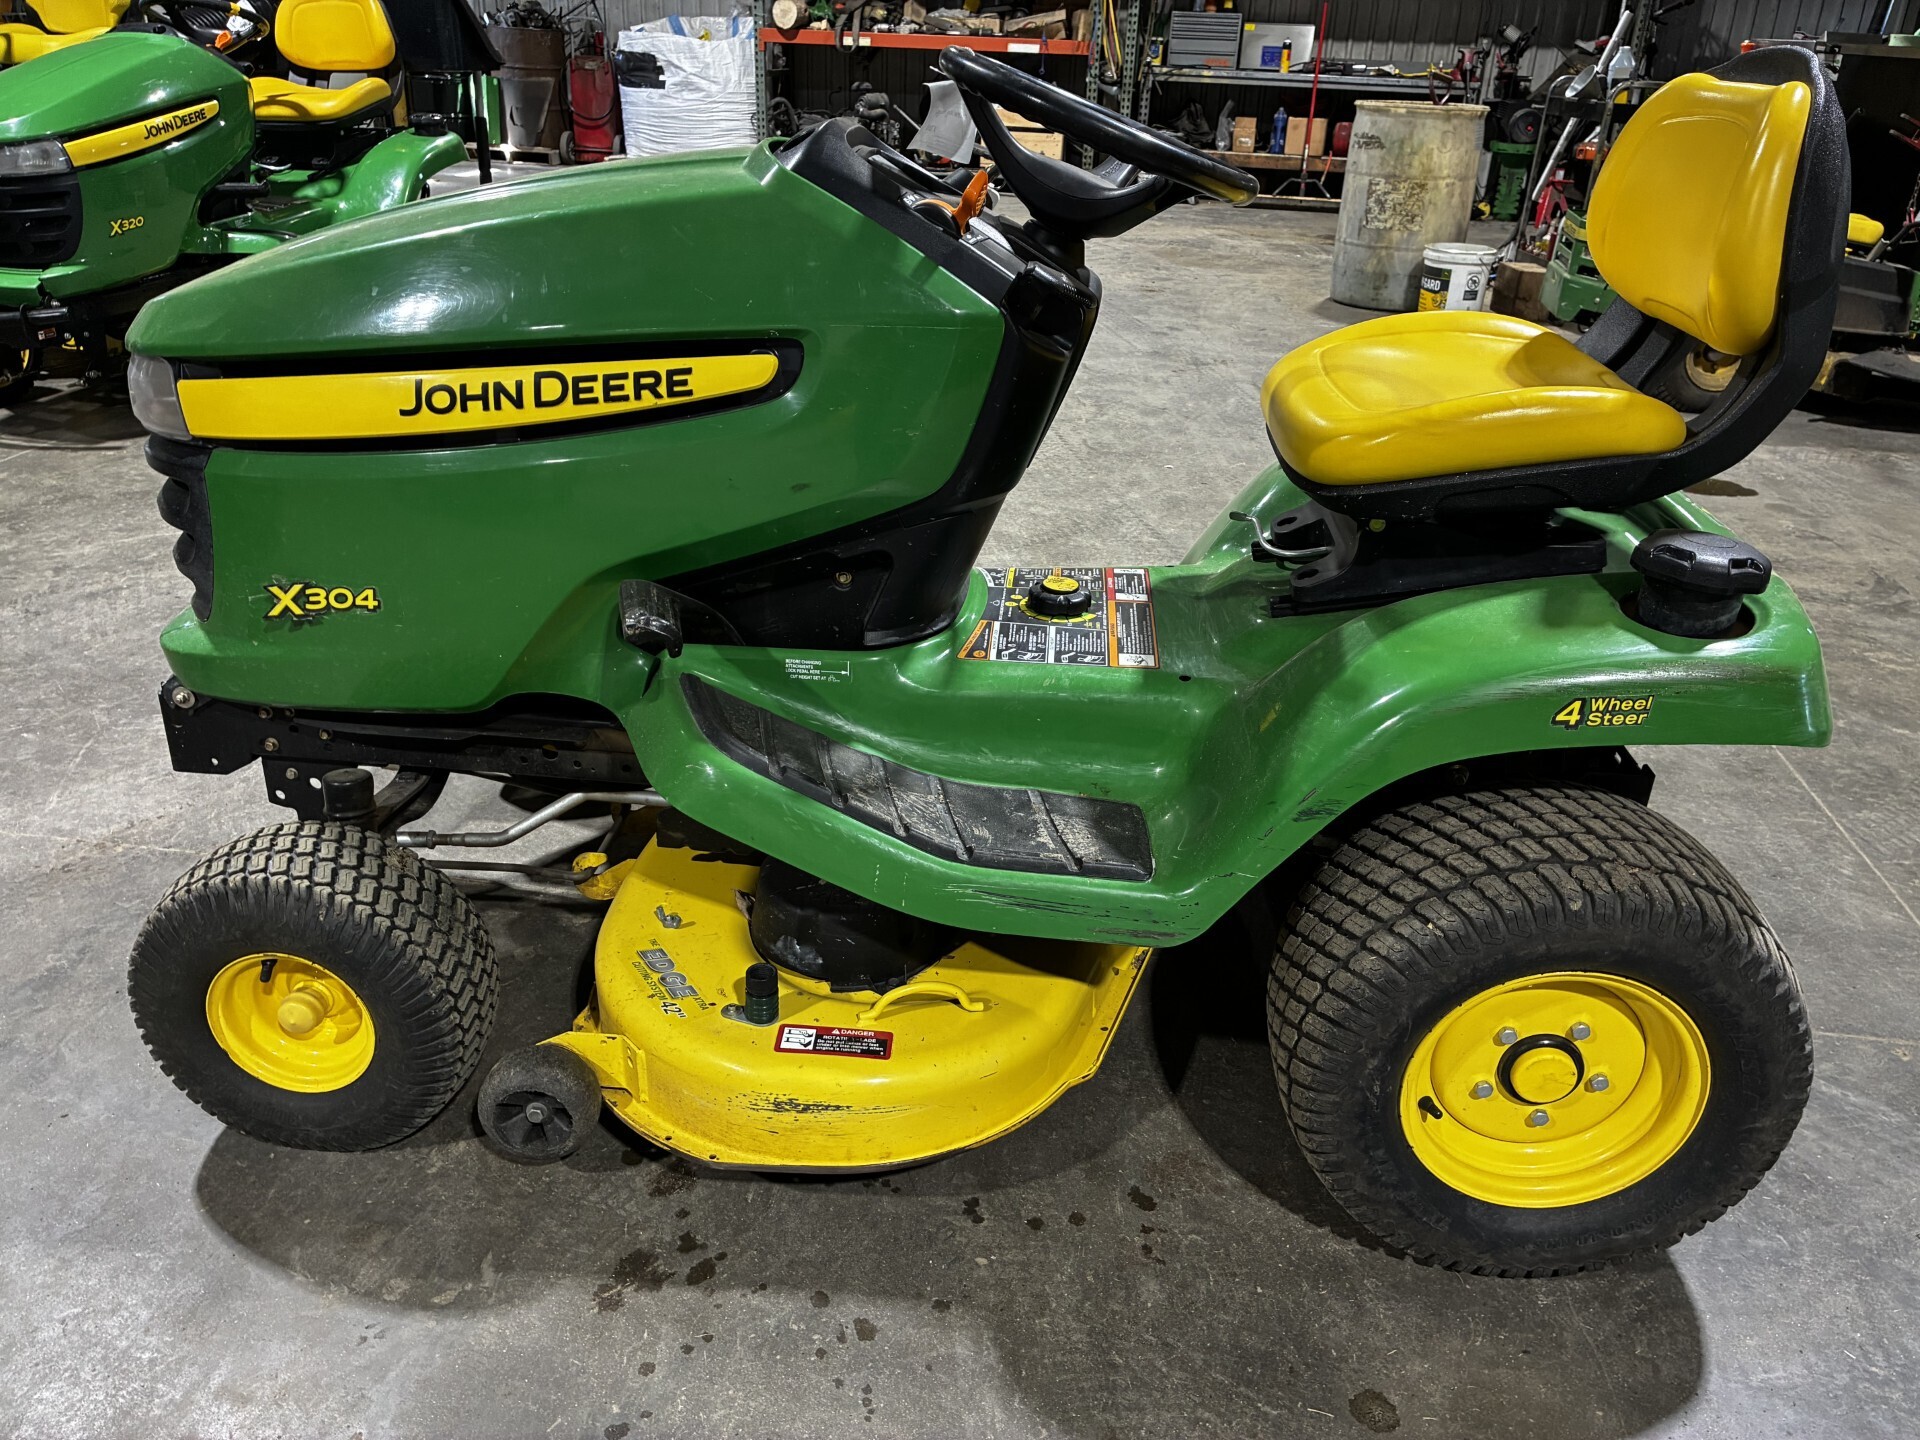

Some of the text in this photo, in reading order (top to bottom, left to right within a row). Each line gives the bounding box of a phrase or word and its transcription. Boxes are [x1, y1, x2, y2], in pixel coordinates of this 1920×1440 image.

[144, 108, 207, 140] JOHN DEERE
[110, 216, 144, 236] X320
[399, 366, 693, 416] JOHN DEERE
[264, 582, 380, 616] X304
[1553, 695, 1653, 727] 4 Wheel
[1586, 712, 1648, 726] Steer
[632, 961, 687, 1018] CUTTING SYSTEM 42"
[637, 948, 699, 999] EDGE
[692, 996, 709, 1011] XTRA
[841, 1029, 875, 1037] DANGER
